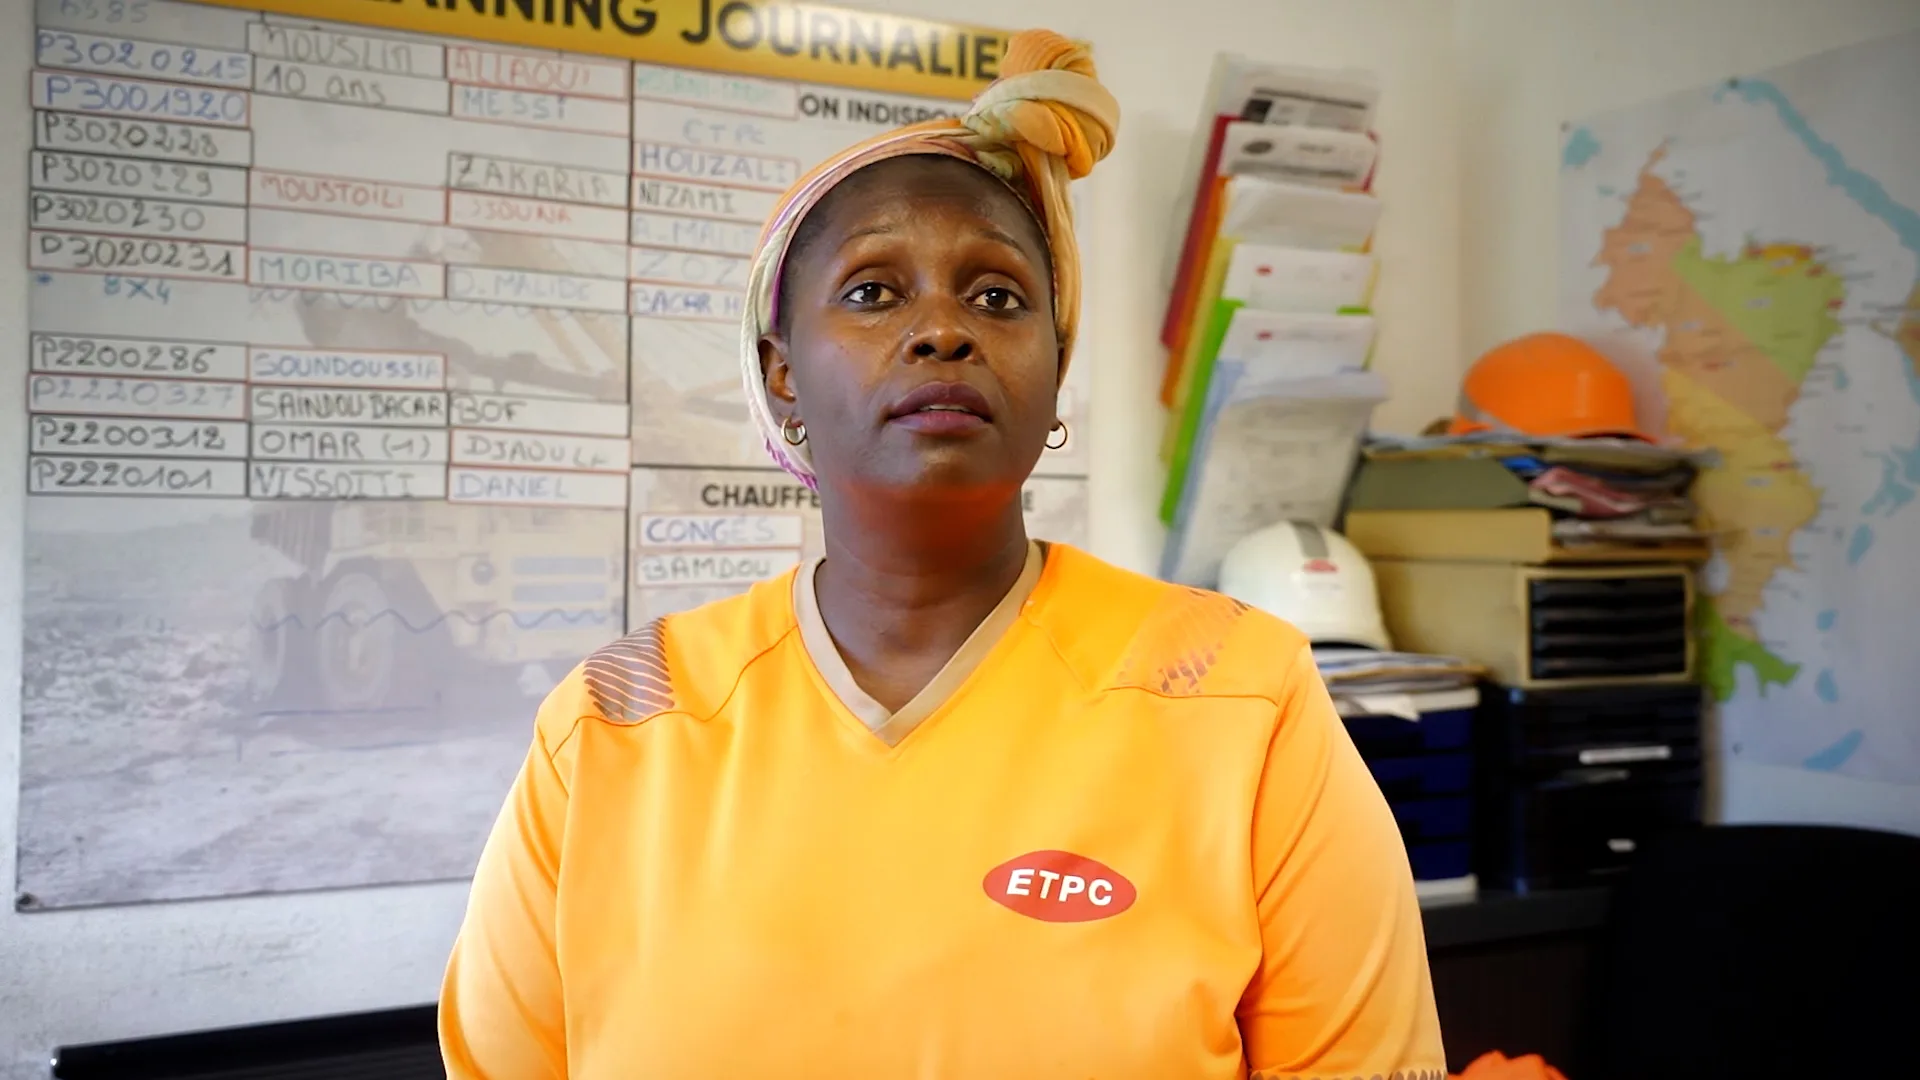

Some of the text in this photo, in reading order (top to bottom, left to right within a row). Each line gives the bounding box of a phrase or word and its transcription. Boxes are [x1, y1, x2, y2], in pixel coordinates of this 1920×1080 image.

[680, 0, 1008, 80] JOURNALIE
[264, 64, 306, 96] 10
[33, 196, 205, 232] P3020230
[259, 256, 421, 288] MORIBA
[34, 335, 216, 373] P2200286
[37, 416, 225, 449] P2200312
[258, 430, 364, 459] OMAR
[34, 458, 212, 490] P2220101
[453, 473, 569, 499] DANIEL
[1006, 868, 1113, 906] ETPC
